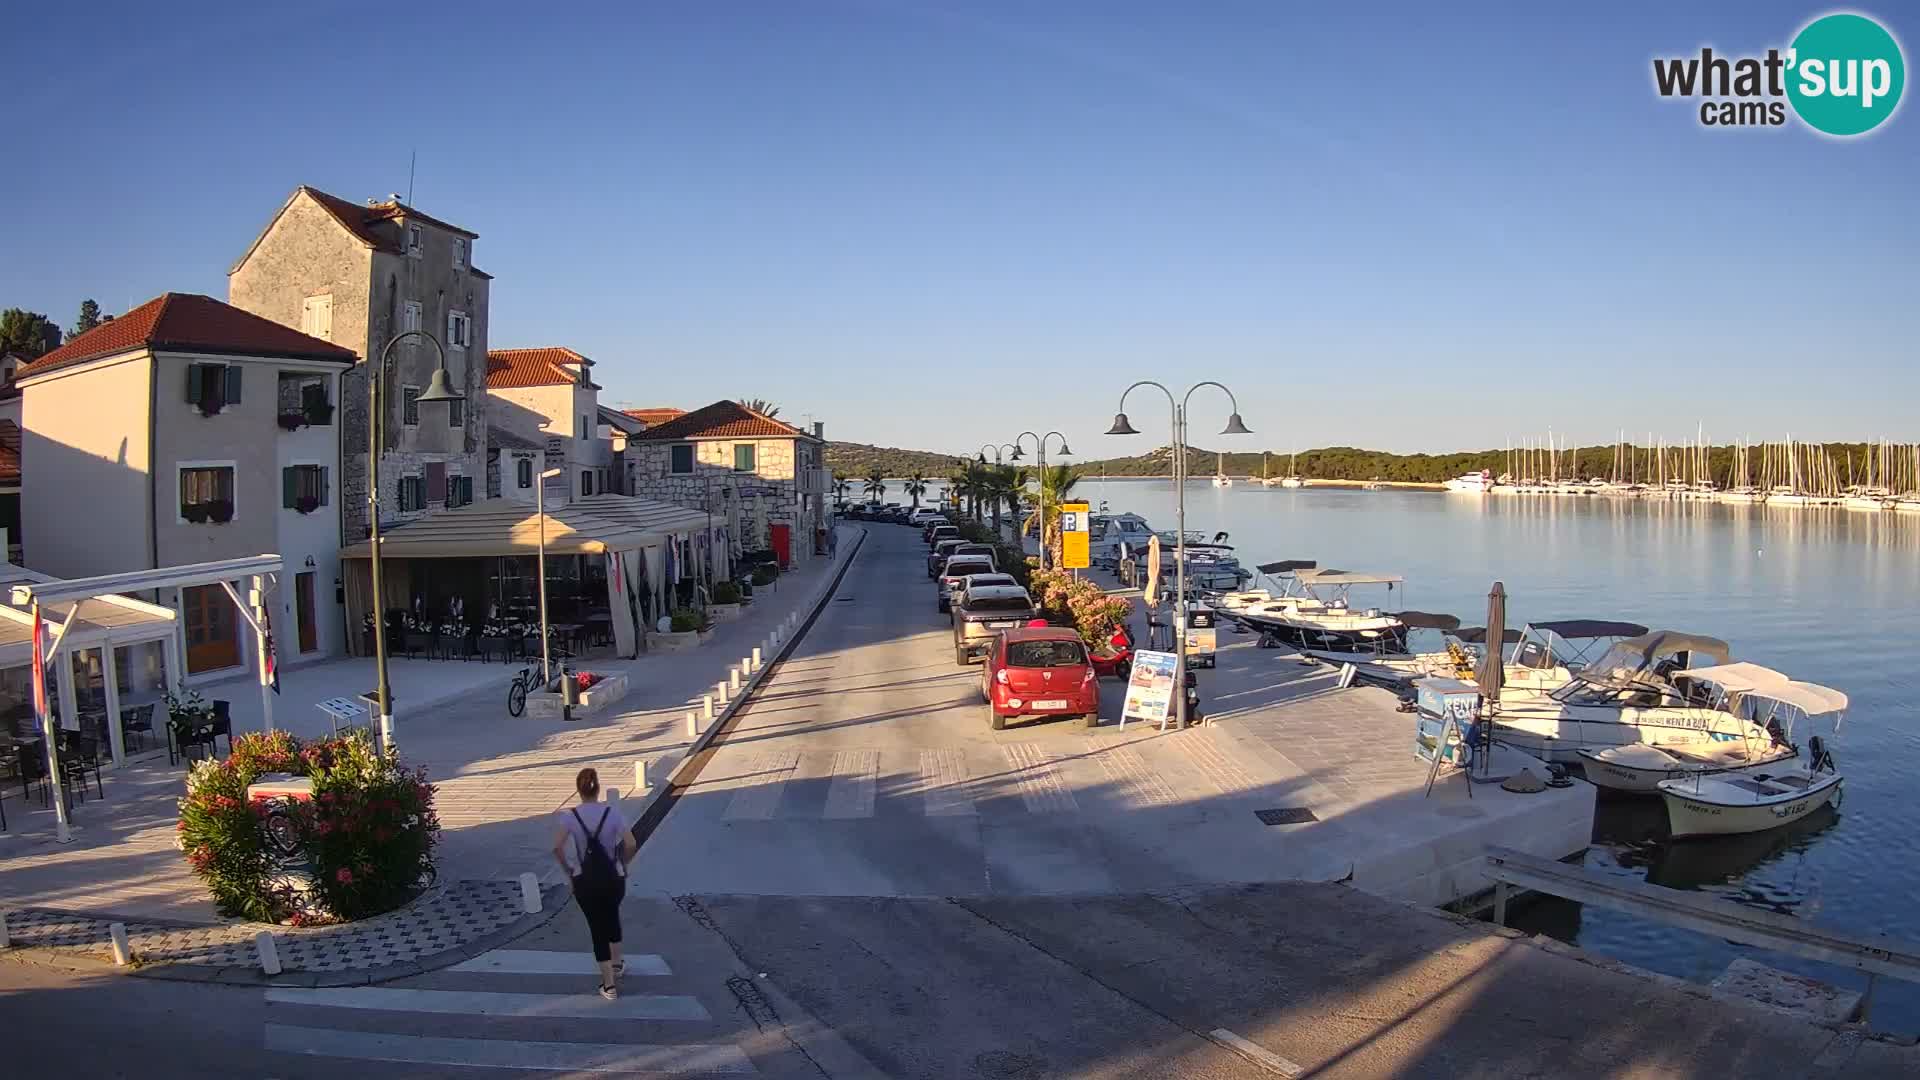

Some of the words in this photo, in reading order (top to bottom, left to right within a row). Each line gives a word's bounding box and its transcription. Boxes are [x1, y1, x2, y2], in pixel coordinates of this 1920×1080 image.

[1443, 697, 1478, 711] RENT
[1665, 717, 1685, 727] RENT
[1686, 718, 1691, 727] A
